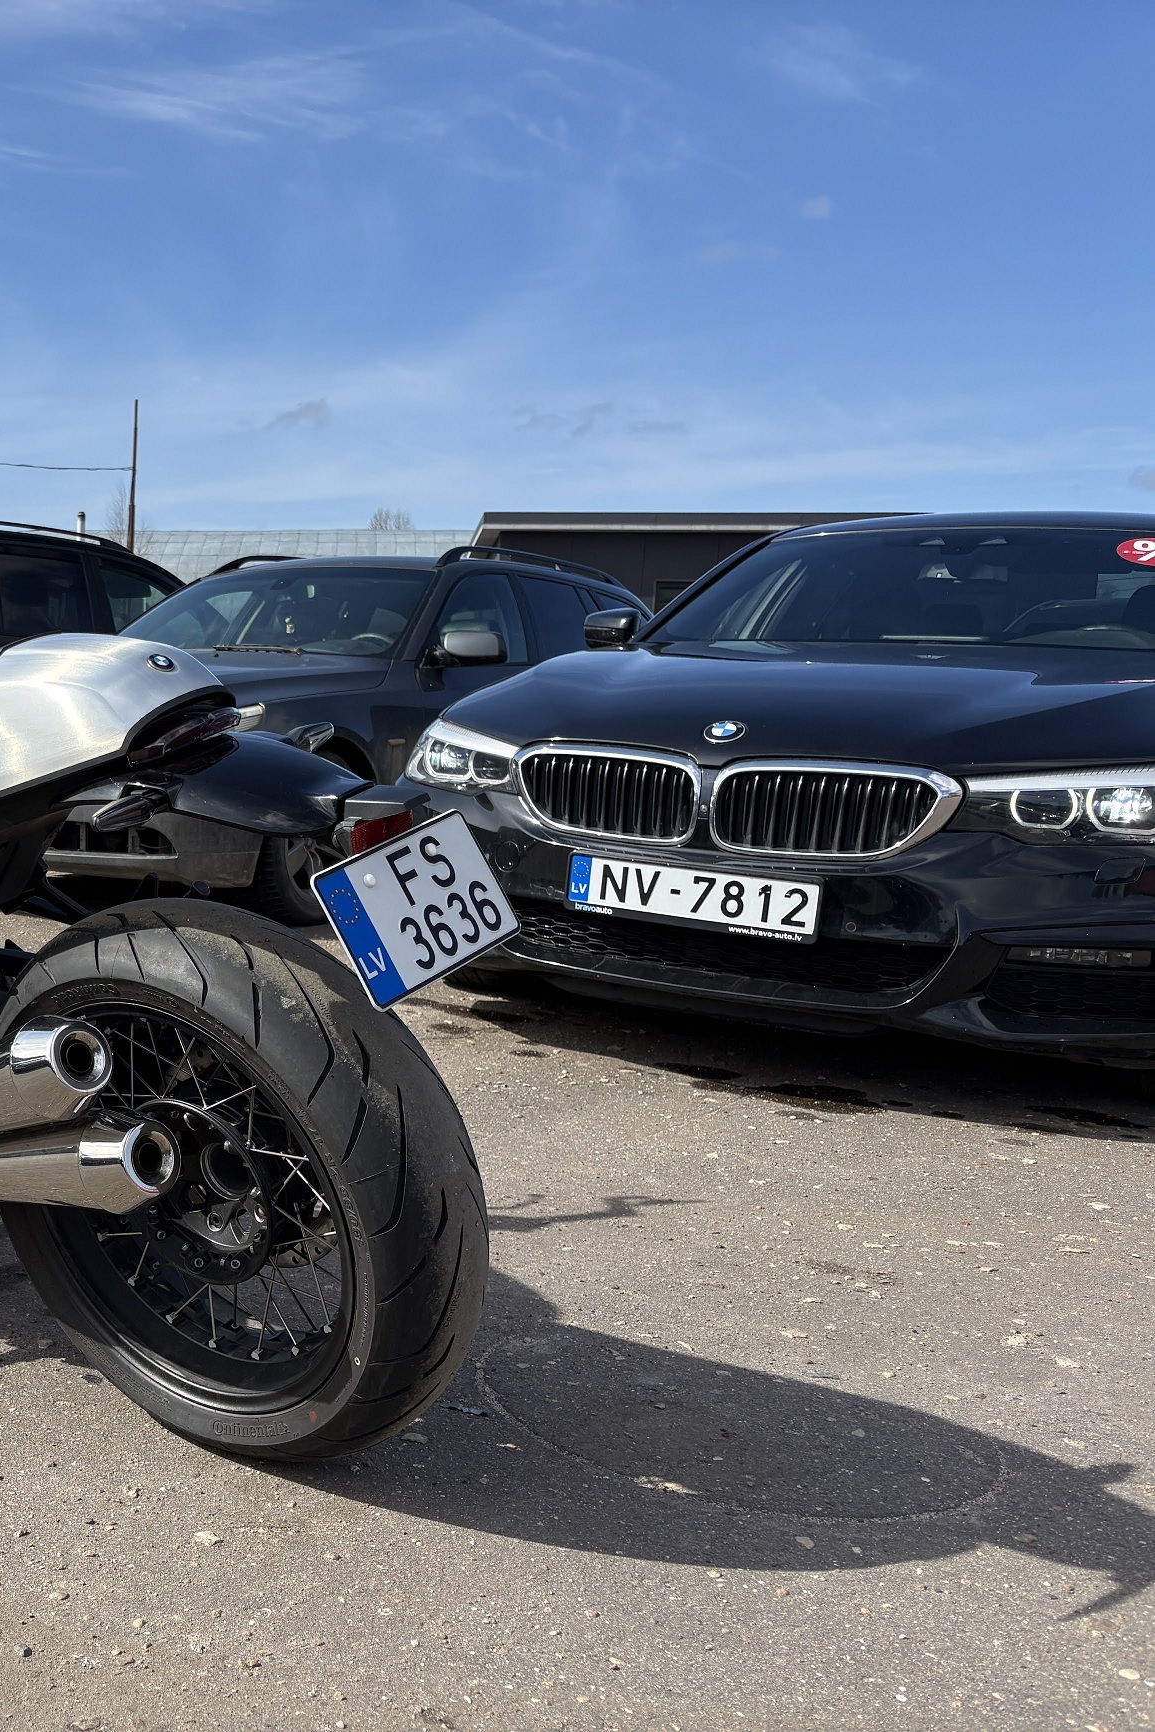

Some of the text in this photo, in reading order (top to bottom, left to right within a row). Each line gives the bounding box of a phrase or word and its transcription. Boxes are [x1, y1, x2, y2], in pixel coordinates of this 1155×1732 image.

[385, 836, 456, 906] FS
[571, 882, 588, 895] LV
[599, 864, 809, 928] NV-7812
[574, 901, 613, 915] bravoauto
[400, 880, 502, 970] 3636
[728, 926, 803, 942] www.bravo-auto.lv
[358, 947, 387, 980] LV
[211, 1418, 280, 1438] Continental
